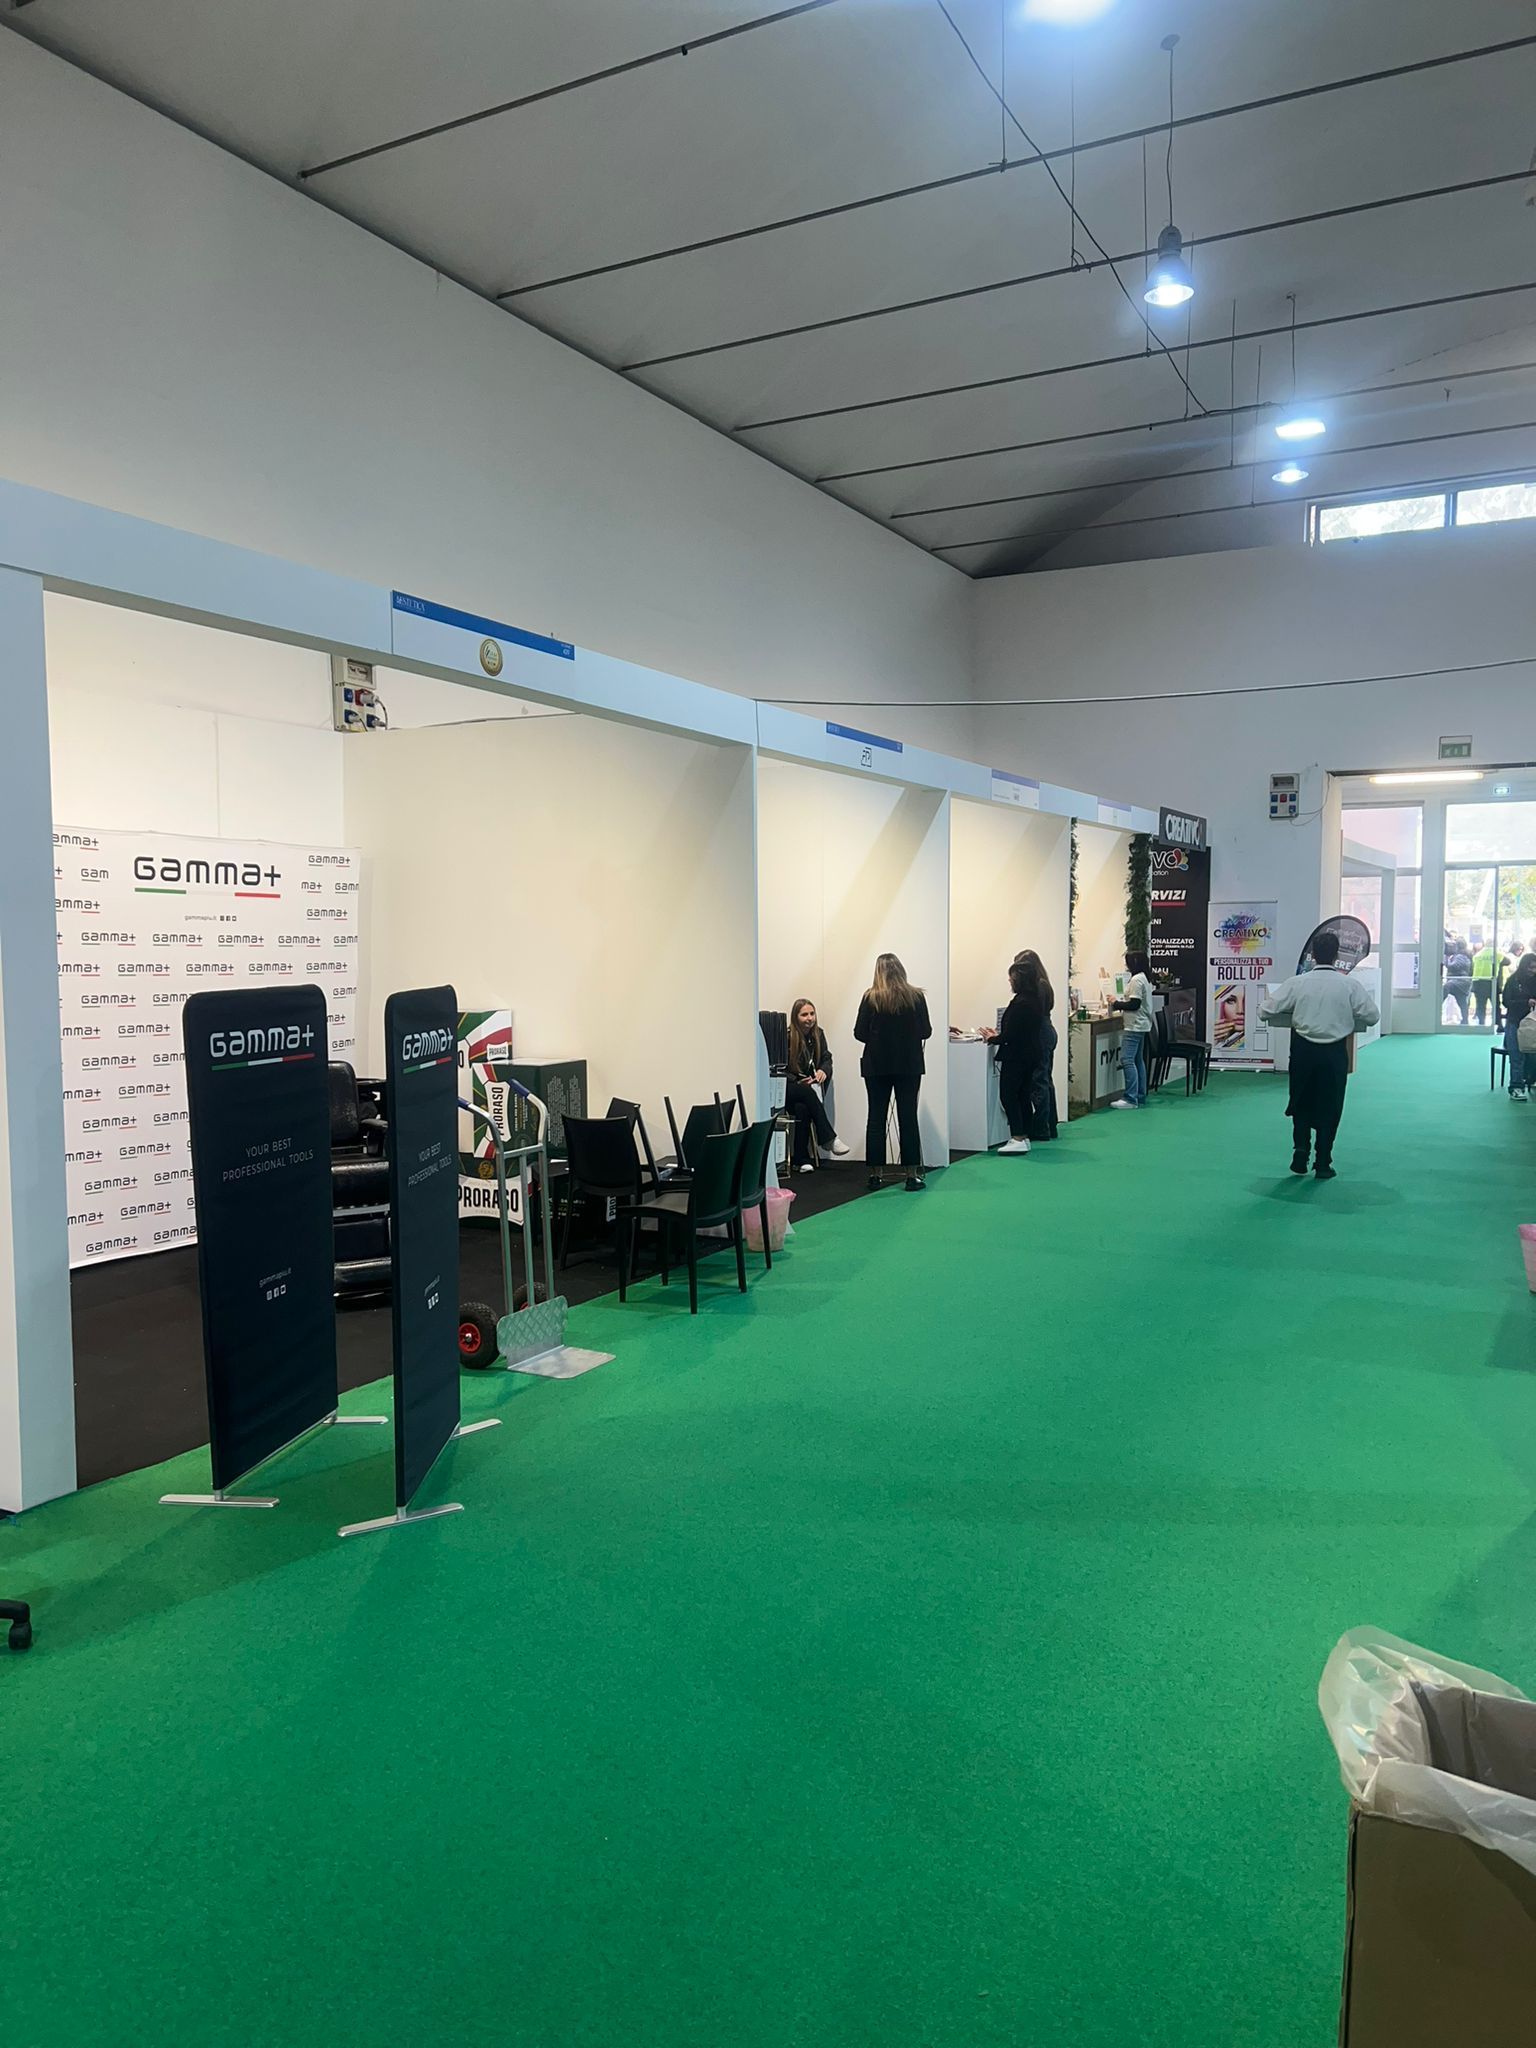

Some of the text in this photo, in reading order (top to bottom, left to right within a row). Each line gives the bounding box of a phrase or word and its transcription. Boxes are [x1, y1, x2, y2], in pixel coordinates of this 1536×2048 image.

[52, 833, 99, 847] amma+
[1151, 889, 1187, 901] RVIZI
[55, 899, 100, 910] amma+
[1213, 927, 1267, 938] CREATIVO
[1151, 949, 1179, 957] LIZZATE
[1217, 966, 1264, 980] ROLL UP
[62, 1025, 101, 1036] mma+
[63, 1088, 101, 1099] mma+
[153, 1111, 189, 1122] Gamm
[245, 1137, 292, 1158] YOUR BEST
[65, 1150, 102, 1162] mma+
[223, 1150, 314, 1182] PROFESSIONAL TOOLS
[67, 1212, 104, 1226] mma+
[153, 1225, 197, 1241] Gamma
